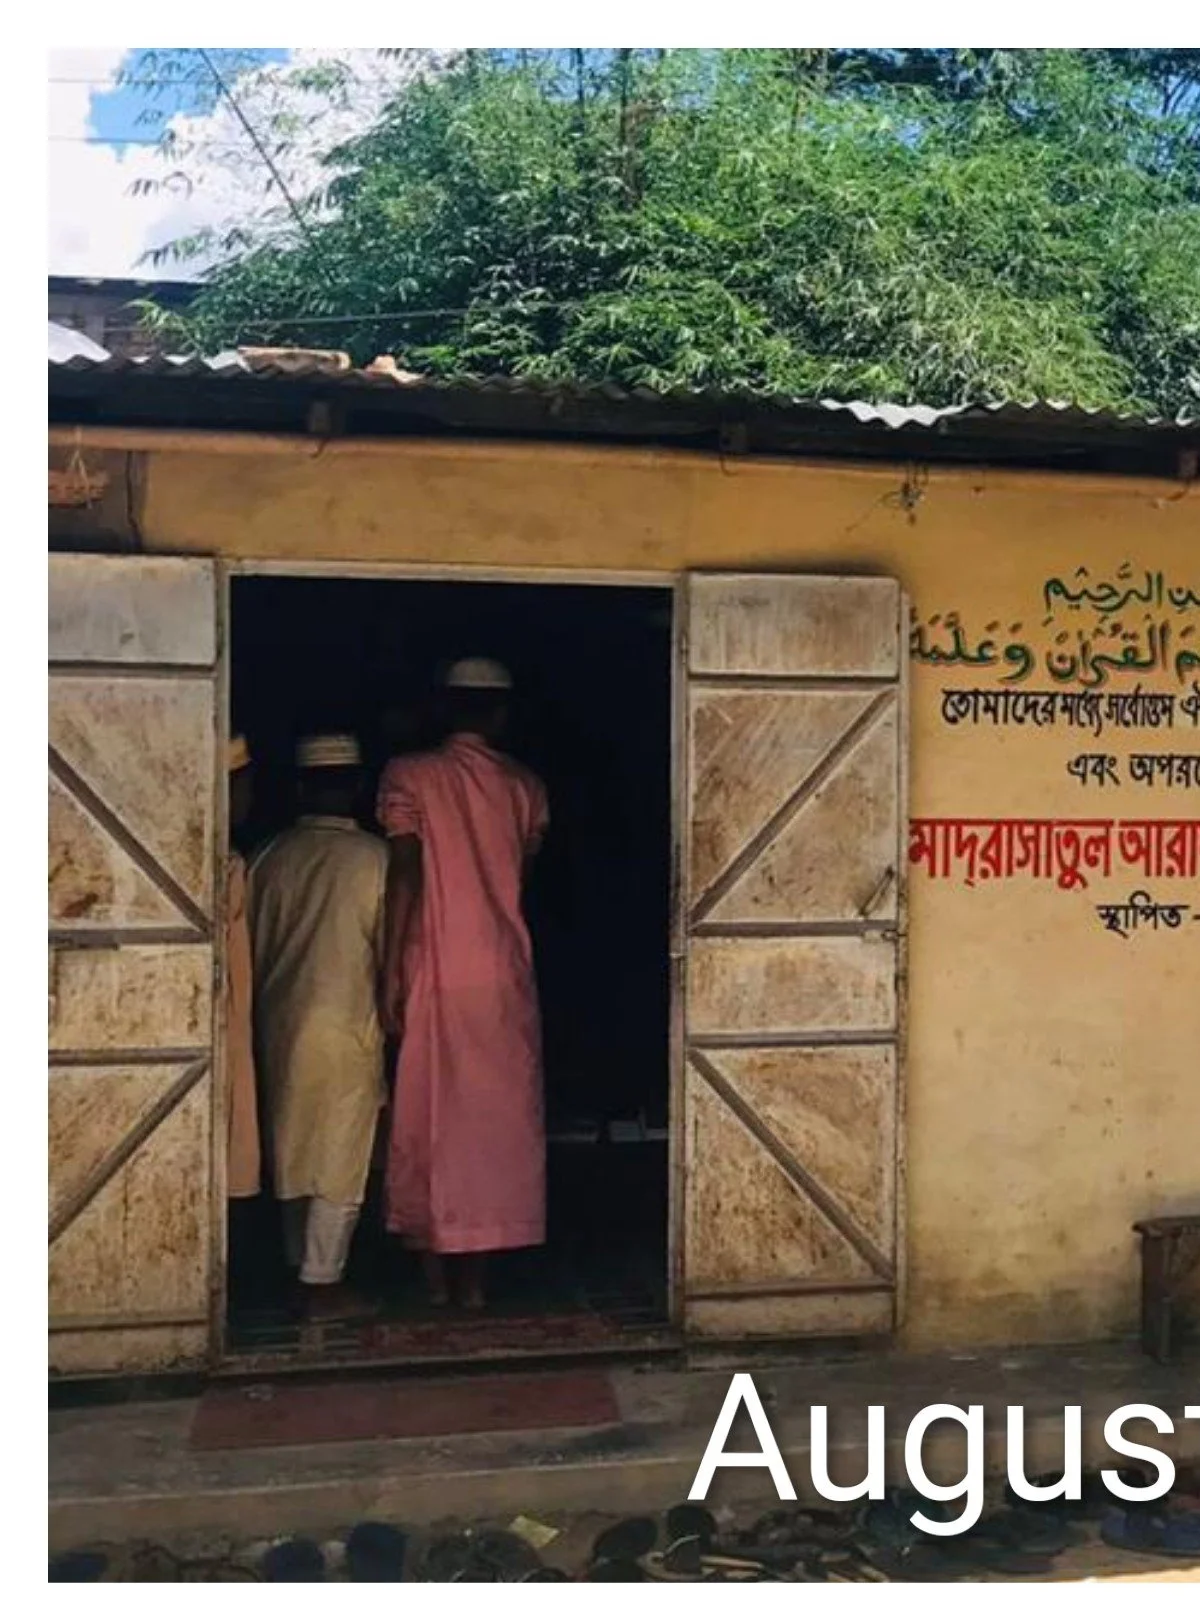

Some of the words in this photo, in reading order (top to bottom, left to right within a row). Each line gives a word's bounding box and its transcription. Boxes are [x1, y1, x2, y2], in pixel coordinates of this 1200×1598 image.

[941, 687, 1058, 726] তোমাদের
[1066, 753, 1121, 787] এবং
[1096, 890, 1190, 939] স্থাপিত
